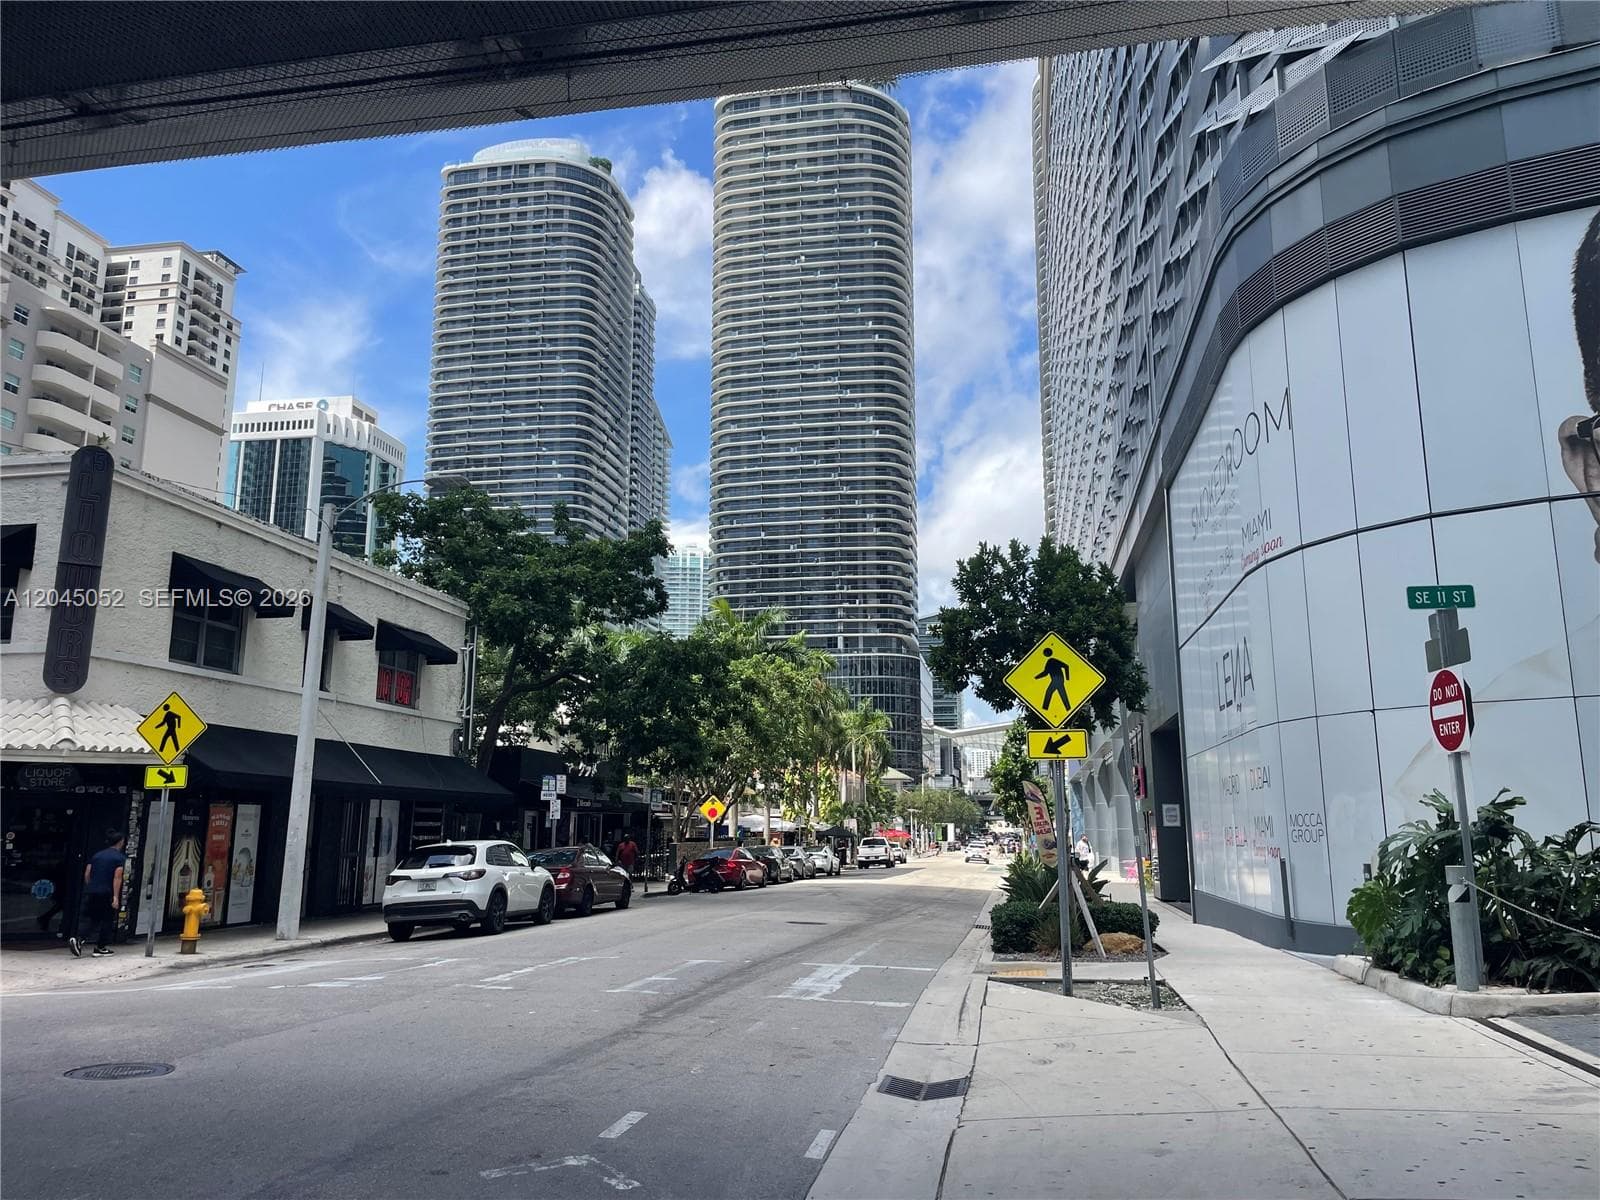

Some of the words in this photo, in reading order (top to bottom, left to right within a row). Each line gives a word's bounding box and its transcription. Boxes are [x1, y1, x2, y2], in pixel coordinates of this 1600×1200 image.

[268, 401, 313, 411] CHASE
[1241, 507, 1271, 547] MIAMI
[1415, 592, 1430, 604] SE
[1437, 591, 1446, 603] 11
[1453, 591, 1467, 603] ST
[1433, 688, 1442, 701] DO
[1445, 683, 1459, 698] NOT
[1439, 720, 1461, 737] ENTER
[25, 767, 73, 778] LIQUOR
[30, 777, 65, 788] STORE
[1289, 813, 1323, 828] MOCCA
[1291, 829, 1325, 843] GROUP
